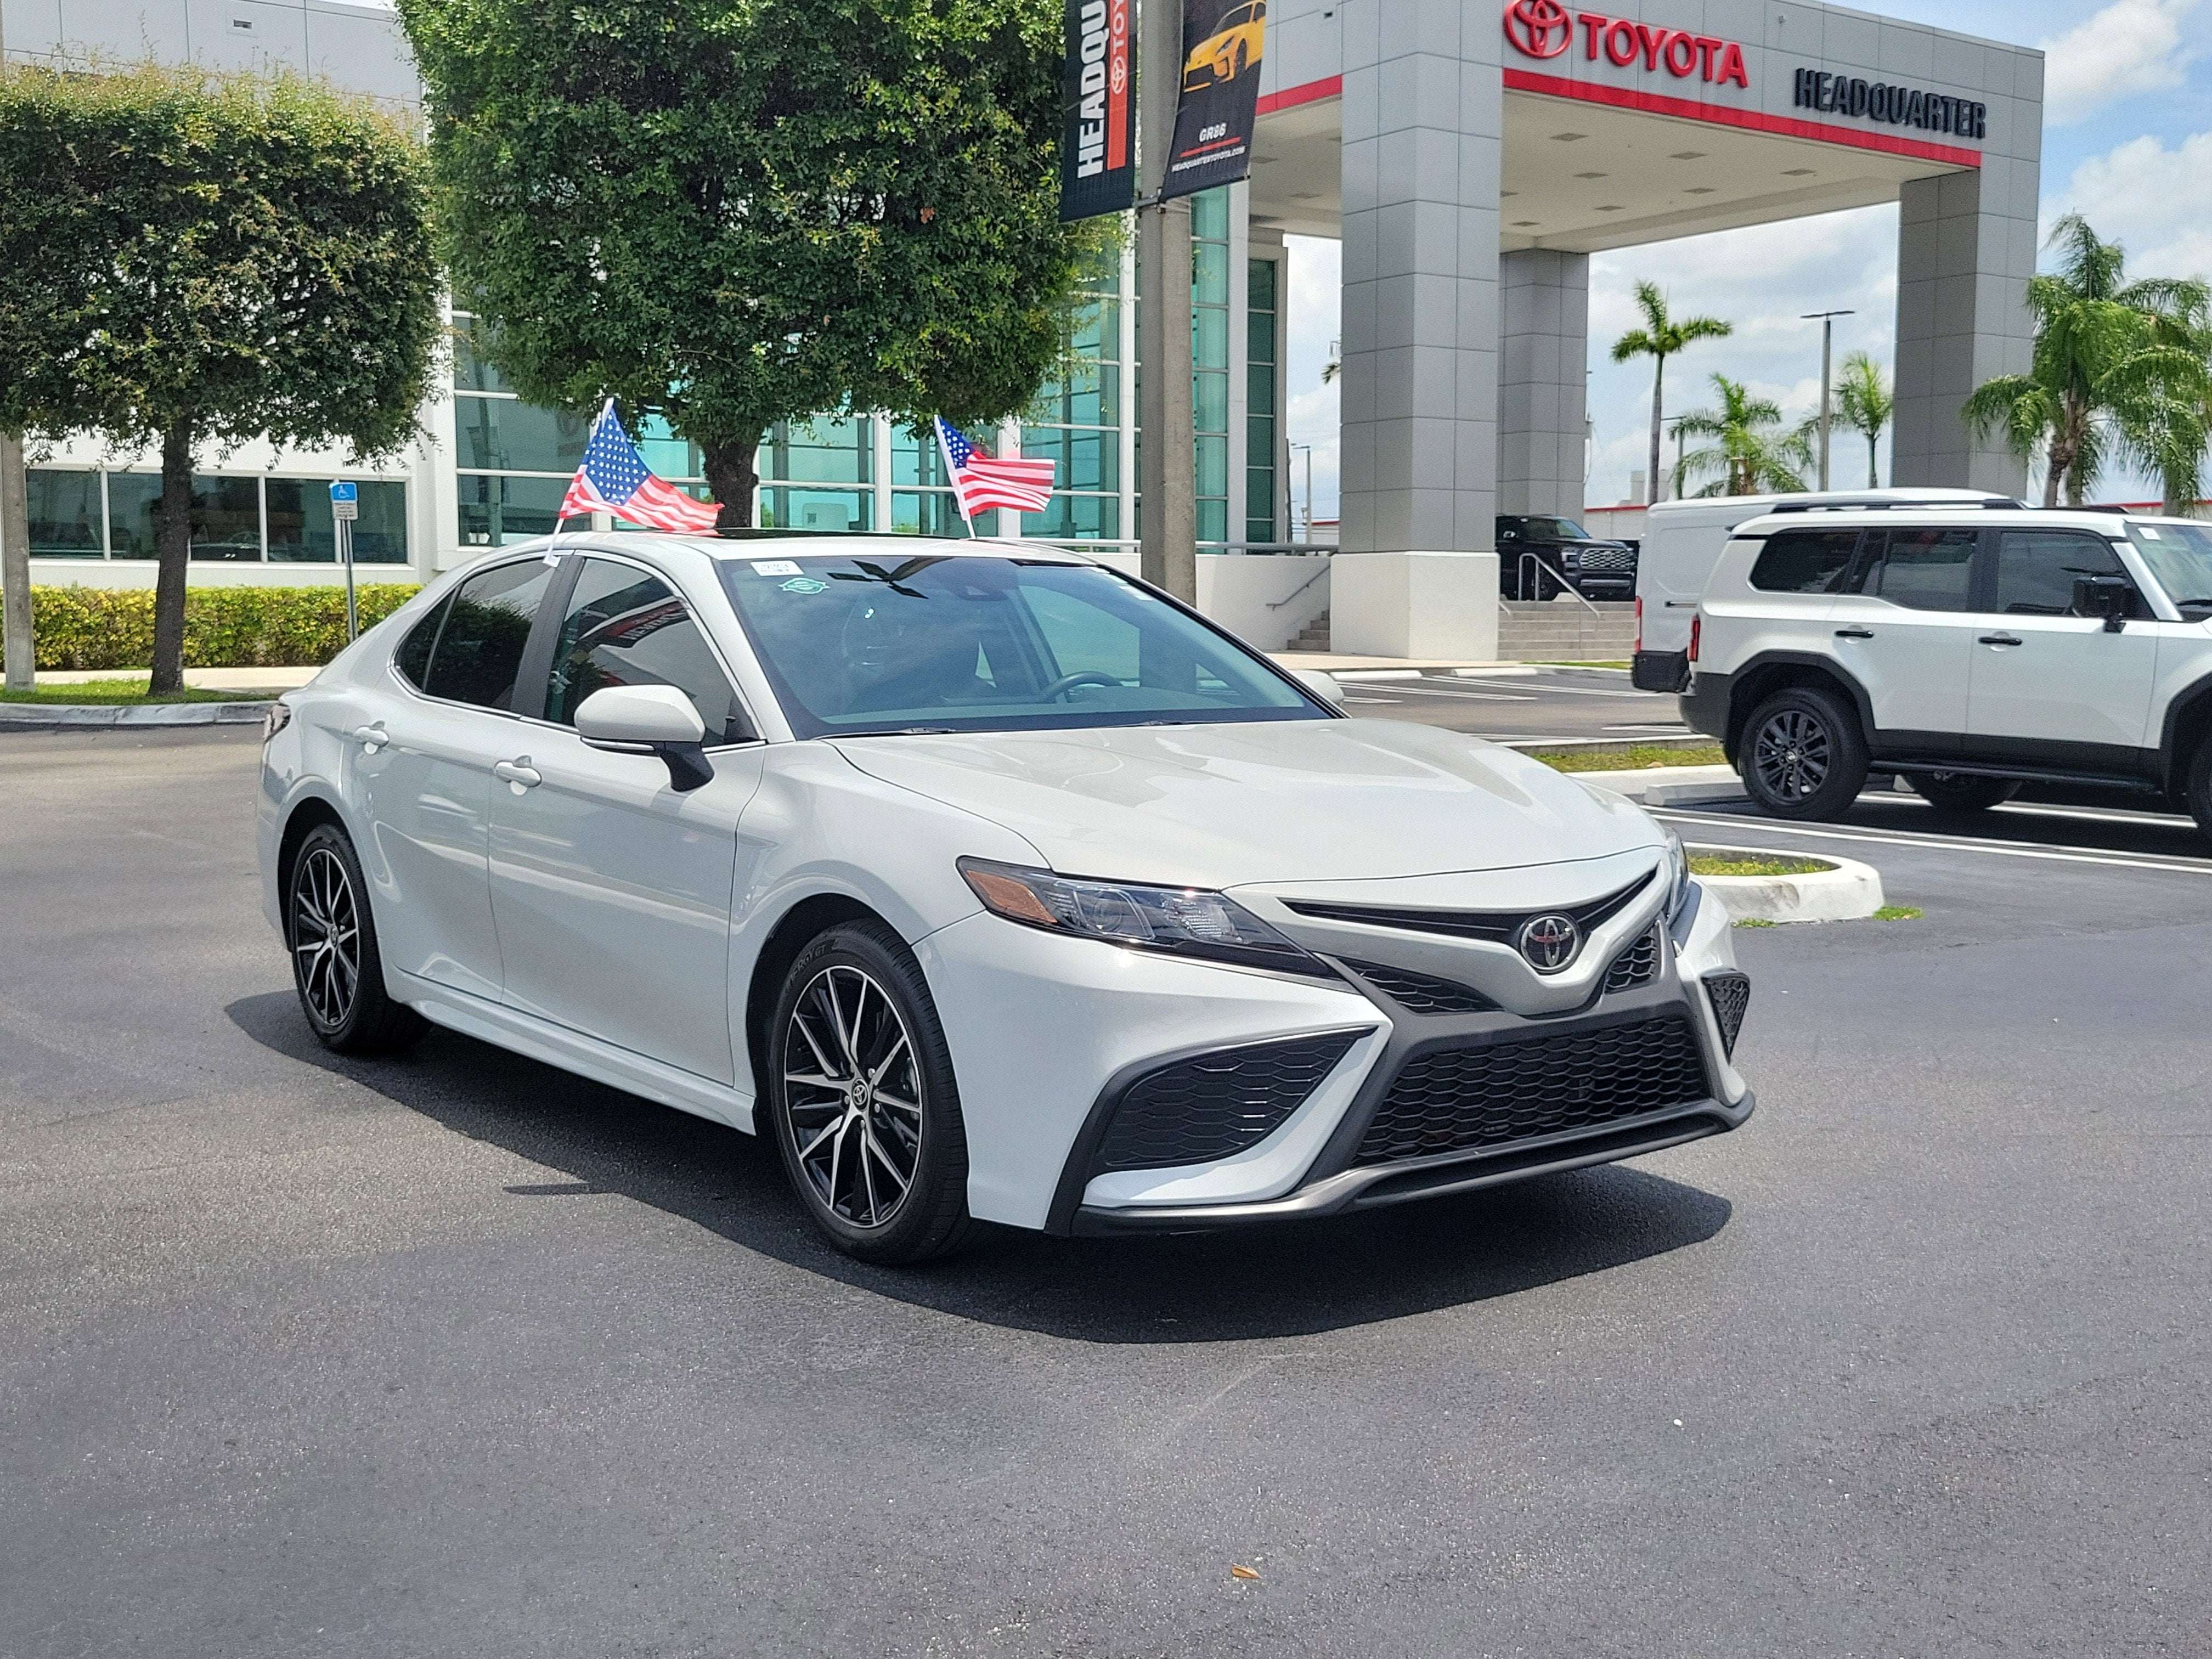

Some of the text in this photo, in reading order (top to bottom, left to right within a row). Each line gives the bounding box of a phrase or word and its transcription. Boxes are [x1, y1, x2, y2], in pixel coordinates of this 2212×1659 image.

[1077, 0, 1109, 178] HEADQU
[1199, 122, 1227, 142] GR86
[1578, 14, 1986, 139] TOYOTA HEADQUARTER
